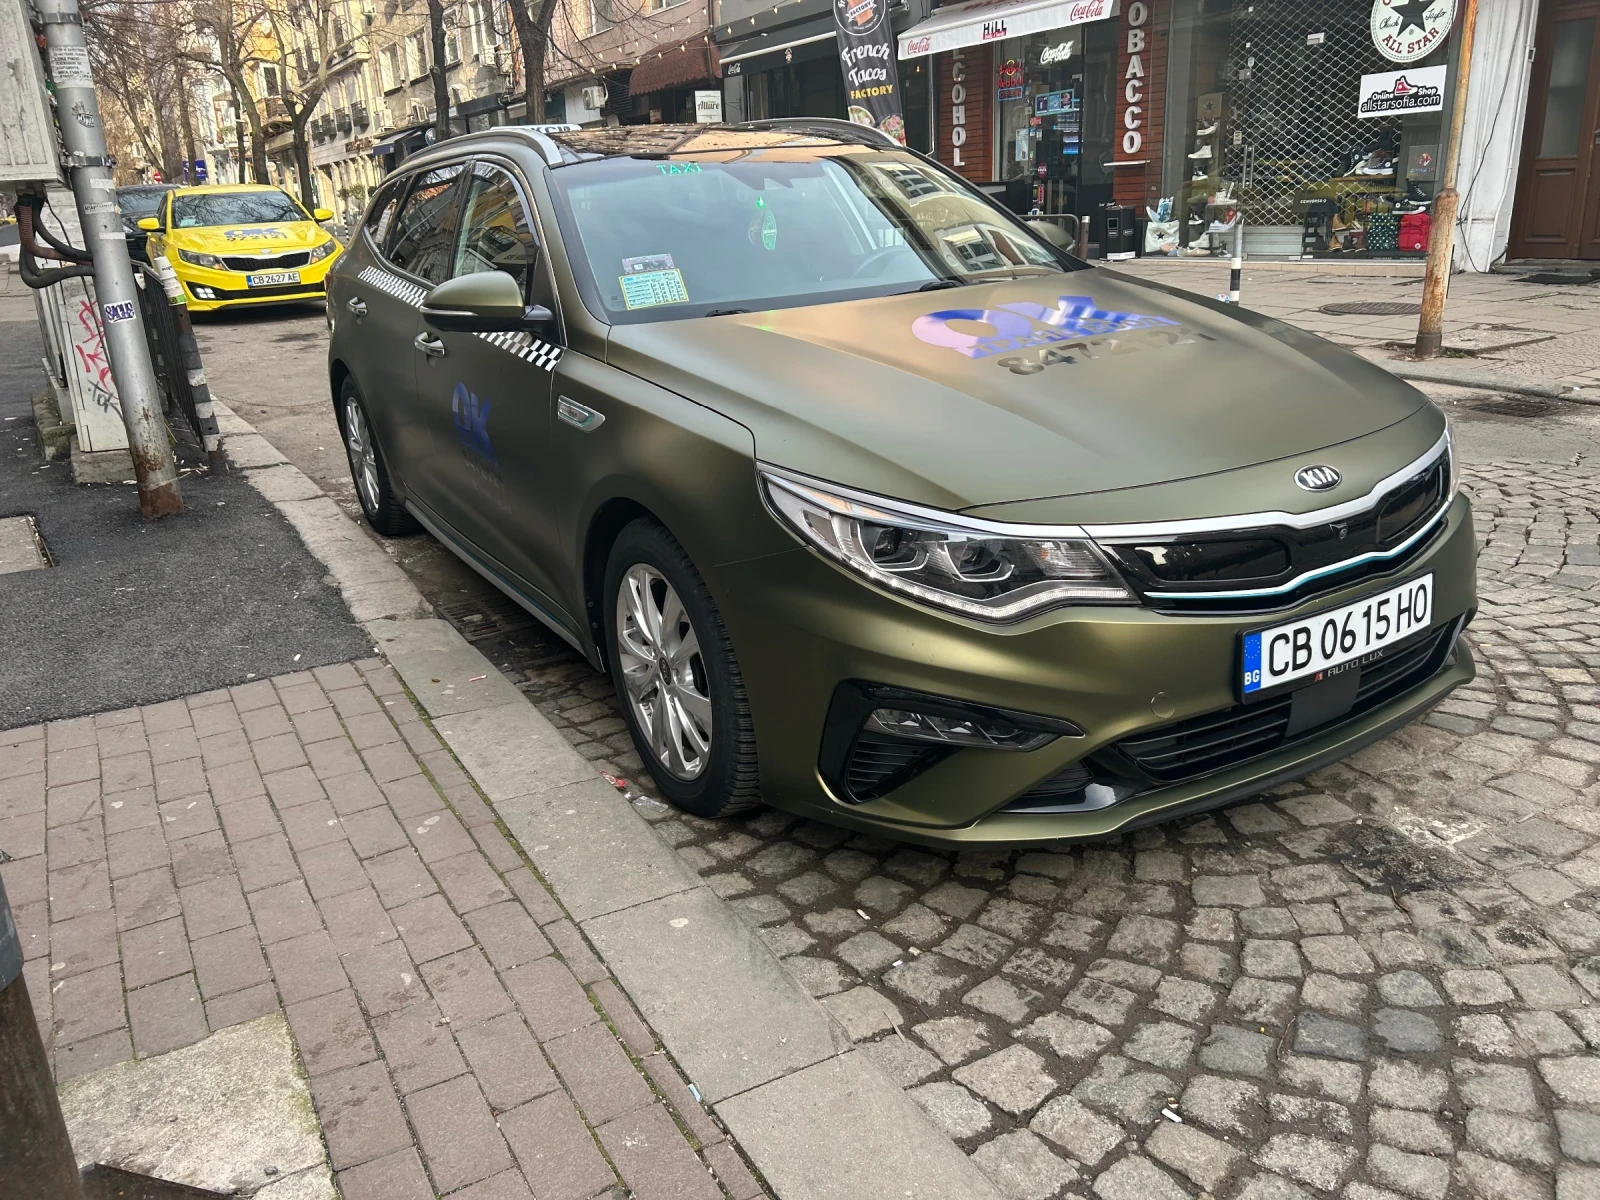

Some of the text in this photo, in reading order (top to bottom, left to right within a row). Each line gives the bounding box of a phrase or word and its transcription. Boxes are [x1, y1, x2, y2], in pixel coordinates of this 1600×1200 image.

[1382, 27, 1440, 54] ALL STAR
[841, 42, 890, 67] French
[848, 67, 887, 86] Tacos
[1122, 1, 1148, 154] OBACCO
[850, 84, 893, 99] FACTORY
[1372, 87, 1437, 100] Online Shop
[697, 100, 720, 111] Allure
[951, 48, 967, 166] LCOHOL
[1361, 95, 1440, 112] allstarsofia.com
[656, 162, 703, 176] TAXI
[252, 275, 265, 285] CB
[266, 274, 286, 284] 2627
[288, 272, 299, 282] AE
[1300, 466, 1339, 487] KIA
[1268, 583, 1428, 677] CB 0615 HO
[1327, 649, 1384, 677] AUTO LUX
[1244, 669, 1260, 686] BG
